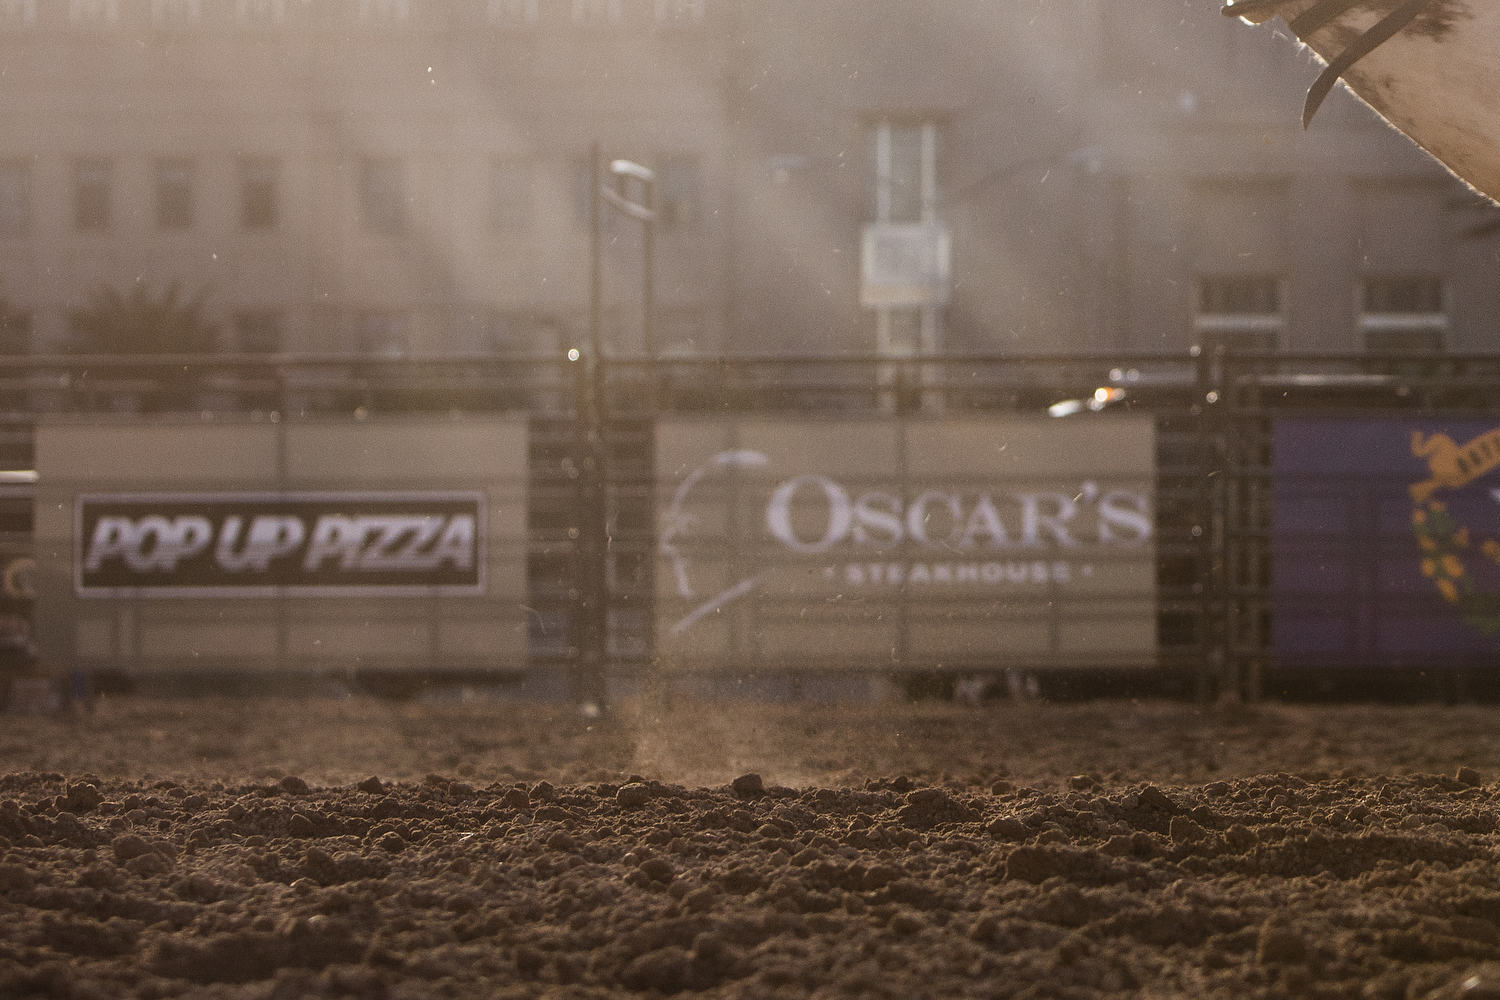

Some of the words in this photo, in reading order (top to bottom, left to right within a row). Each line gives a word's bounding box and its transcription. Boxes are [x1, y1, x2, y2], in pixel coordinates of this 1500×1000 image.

[86, 515, 213, 572] POP
[215, 515, 305, 571] UP
[303, 514, 475, 571] PIZZA
[767, 474, 1153, 554] OSCAR'S
[845, 561, 1071, 584] STEAKHOUSE
